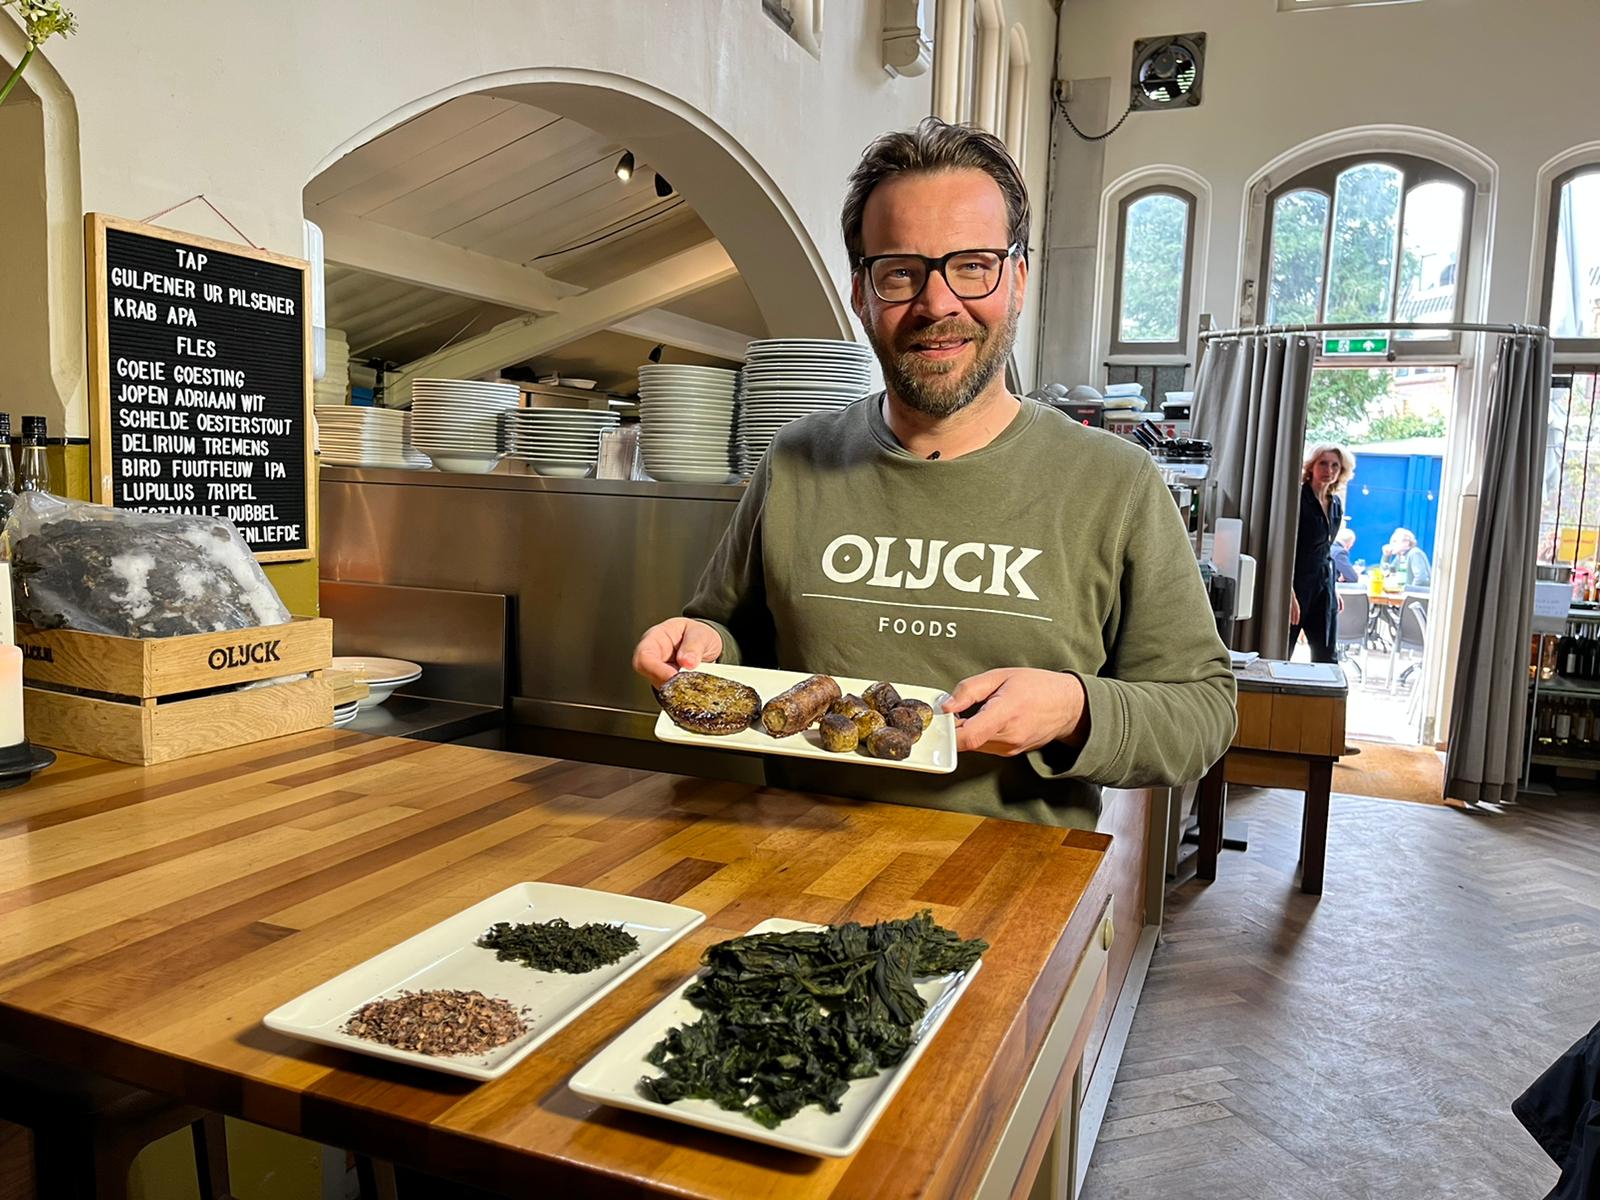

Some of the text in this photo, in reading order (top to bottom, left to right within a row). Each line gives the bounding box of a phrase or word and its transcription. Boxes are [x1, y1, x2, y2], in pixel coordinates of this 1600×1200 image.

[175, 249, 208, 272] TAP
[111, 267, 295, 316] GULPENER UR PILSENER
[114, 298, 197, 327] KRAB APA
[177, 336, 216, 358] FLES
[116, 357, 245, 389] GOEIE GOESTING
[118, 384, 265, 413] JOPEN ADRIAAN WIT
[119, 409, 292, 436] SCHELDE OESTERSTOUT
[121, 433, 269, 457] DELIRIUM TREMENS
[121, 458, 286, 480] BIRD FUUTFIEUW IPA
[122, 482, 257, 502] LUPULUS TRIPEL
[124, 504, 279, 522] MALLE DUBBEL
[878, 616, 957, 638] FOODS
